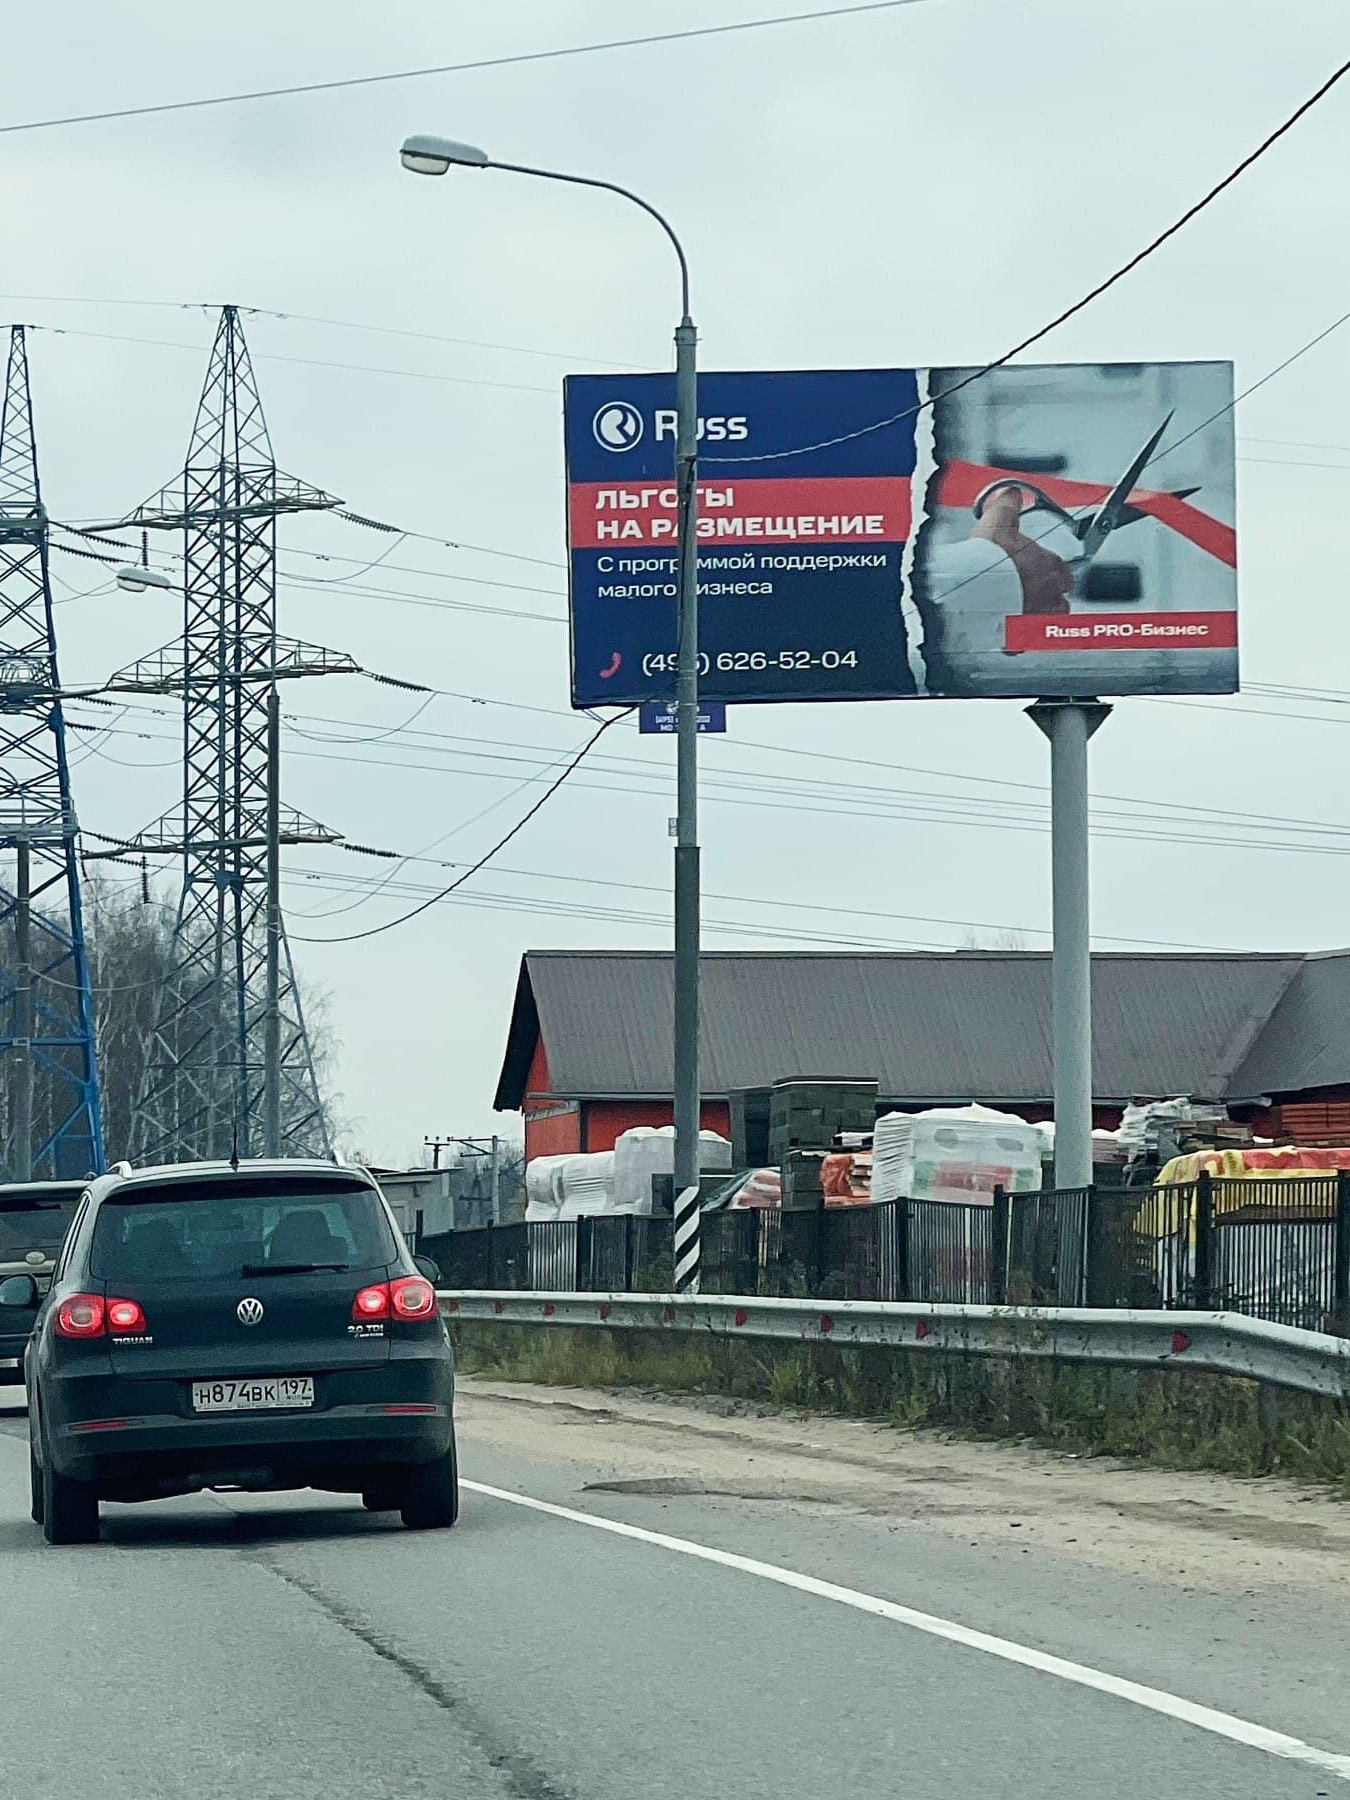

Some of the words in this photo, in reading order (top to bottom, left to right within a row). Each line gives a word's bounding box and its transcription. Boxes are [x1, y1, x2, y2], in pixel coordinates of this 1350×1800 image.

[597, 520, 643, 539] НА
[651, 515, 884, 538] РЗМЕЩЕНИЕ
[597, 556, 613, 572] С
[618, 553, 755, 575] прогрммой
[760, 554, 887, 571] поддержки
[598, 584, 677, 598] малого
[696, 581, 773, 595] изнеса
[1045, 625, 1090, 637] Russ
[1093, 623, 1209, 637] PRO-Бизнес
[716, 650, 858, 671] 626-52-04
[280, 1379, 308, 1395] 197
